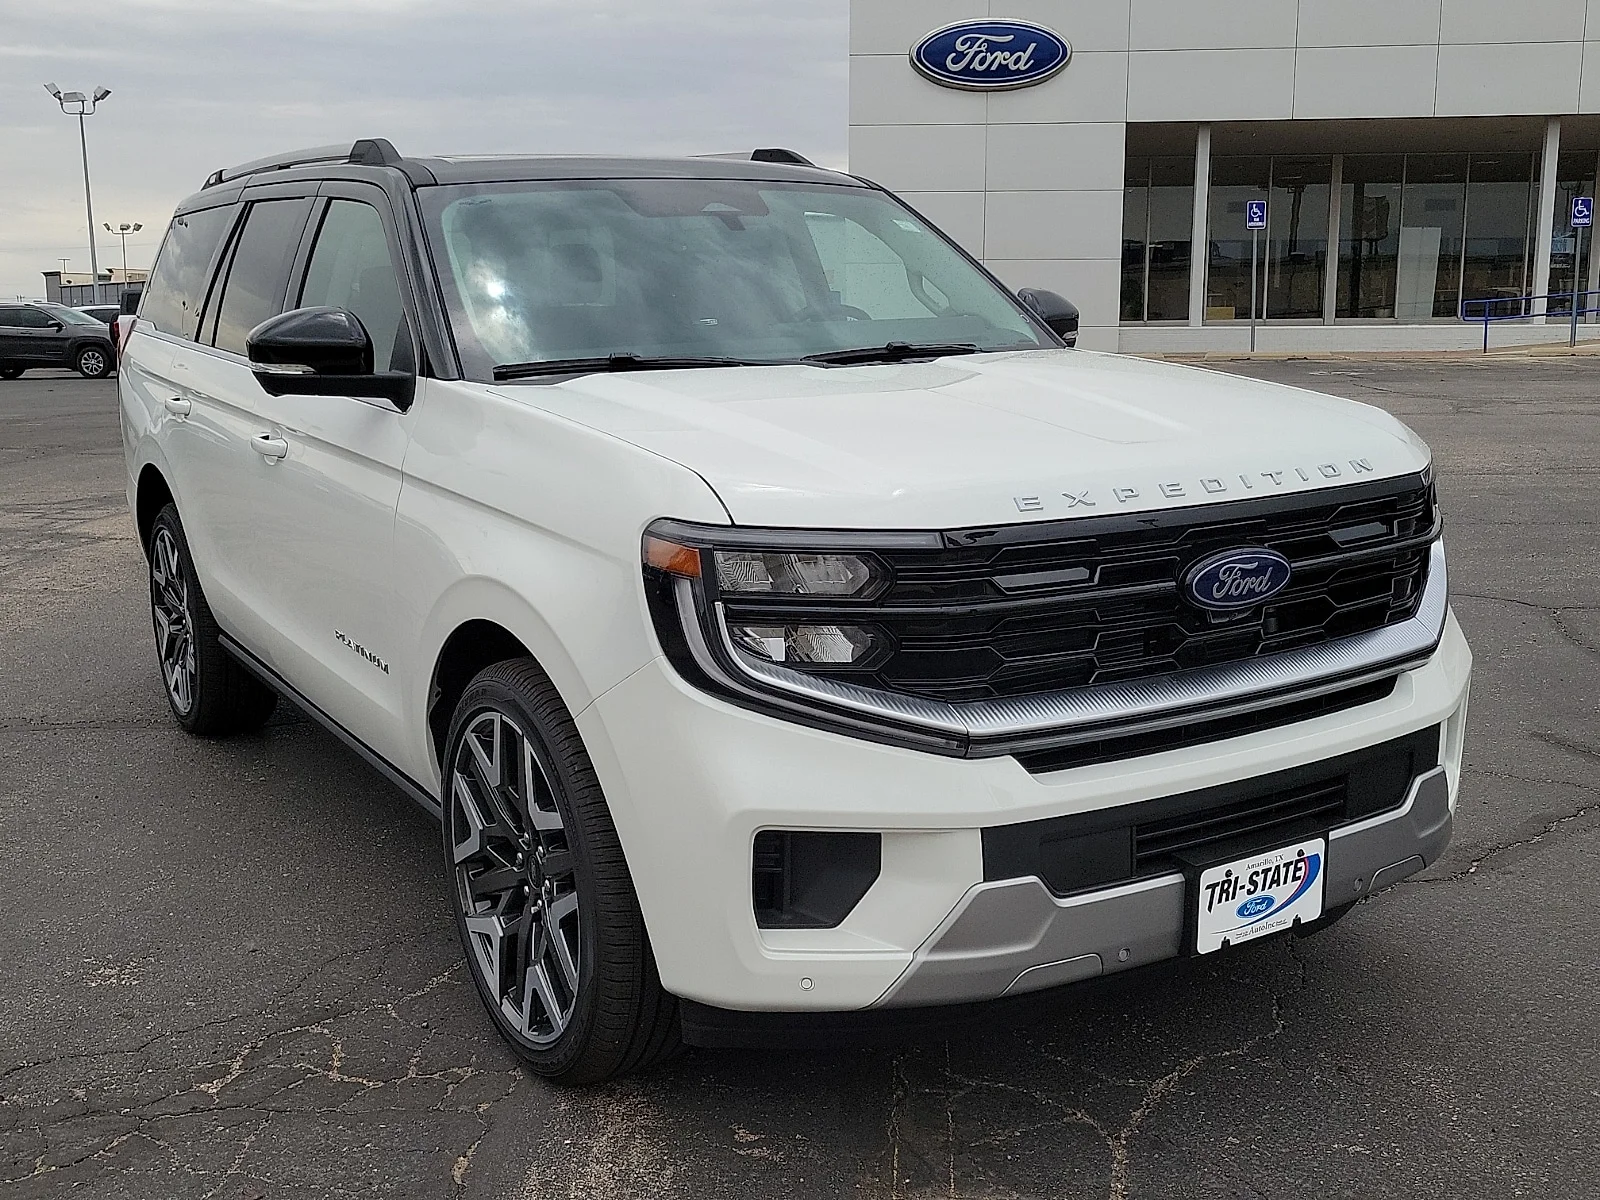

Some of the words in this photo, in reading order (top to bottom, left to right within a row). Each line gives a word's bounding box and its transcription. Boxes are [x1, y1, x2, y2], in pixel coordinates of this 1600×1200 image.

[946, 33, 1037, 72] Ford
[1013, 457, 1374, 513] EXPEDITION
[1212, 561, 1272, 600] Ford
[334, 629, 390, 675] PLATINUM
[1205, 859, 1304, 914] TRI-STATE
[1244, 898, 1268, 916] Ford
